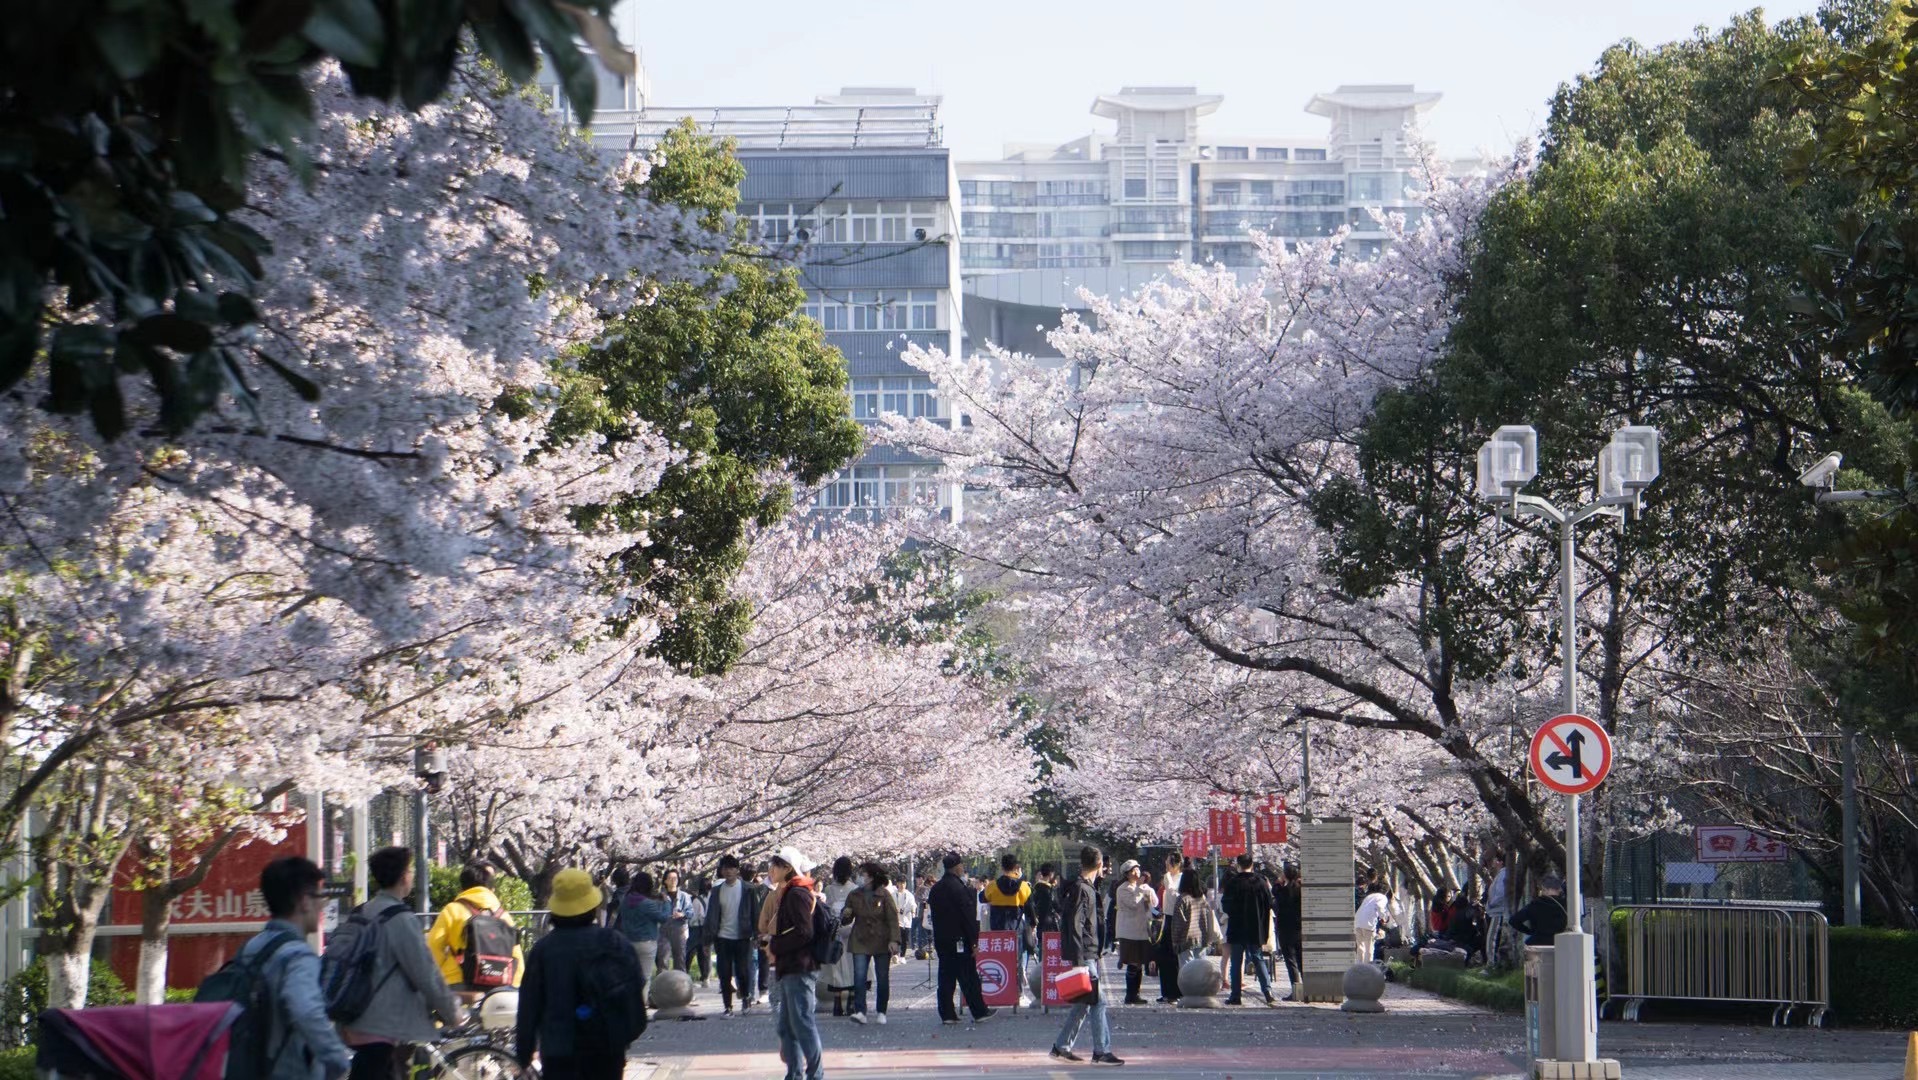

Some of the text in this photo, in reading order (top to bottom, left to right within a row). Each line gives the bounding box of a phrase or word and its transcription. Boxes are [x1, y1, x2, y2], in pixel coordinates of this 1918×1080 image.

[977, 937, 1015, 953] 要活动
[1047, 938, 1061, 950] 樱
